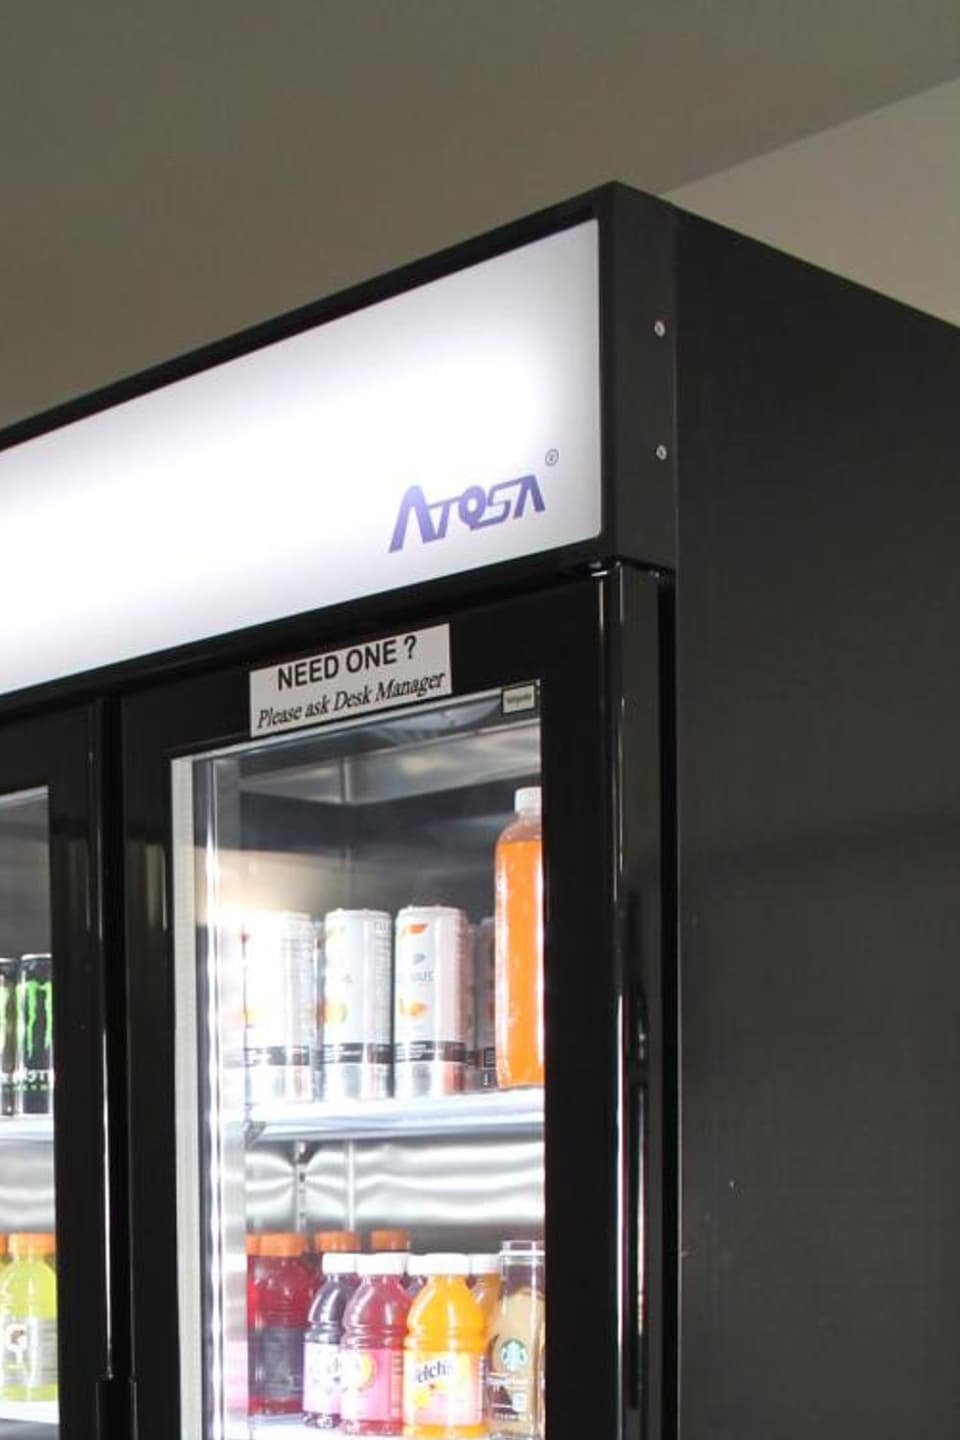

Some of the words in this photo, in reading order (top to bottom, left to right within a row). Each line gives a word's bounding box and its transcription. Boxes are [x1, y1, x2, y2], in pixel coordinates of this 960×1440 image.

[278, 655, 340, 691] NEED
[345, 639, 398, 673] ONE
[257, 705, 303, 730] Please
[305, 696, 331, 716] ask
[333, 683, 373, 712] Desk
[375, 671, 446, 703] Manager
